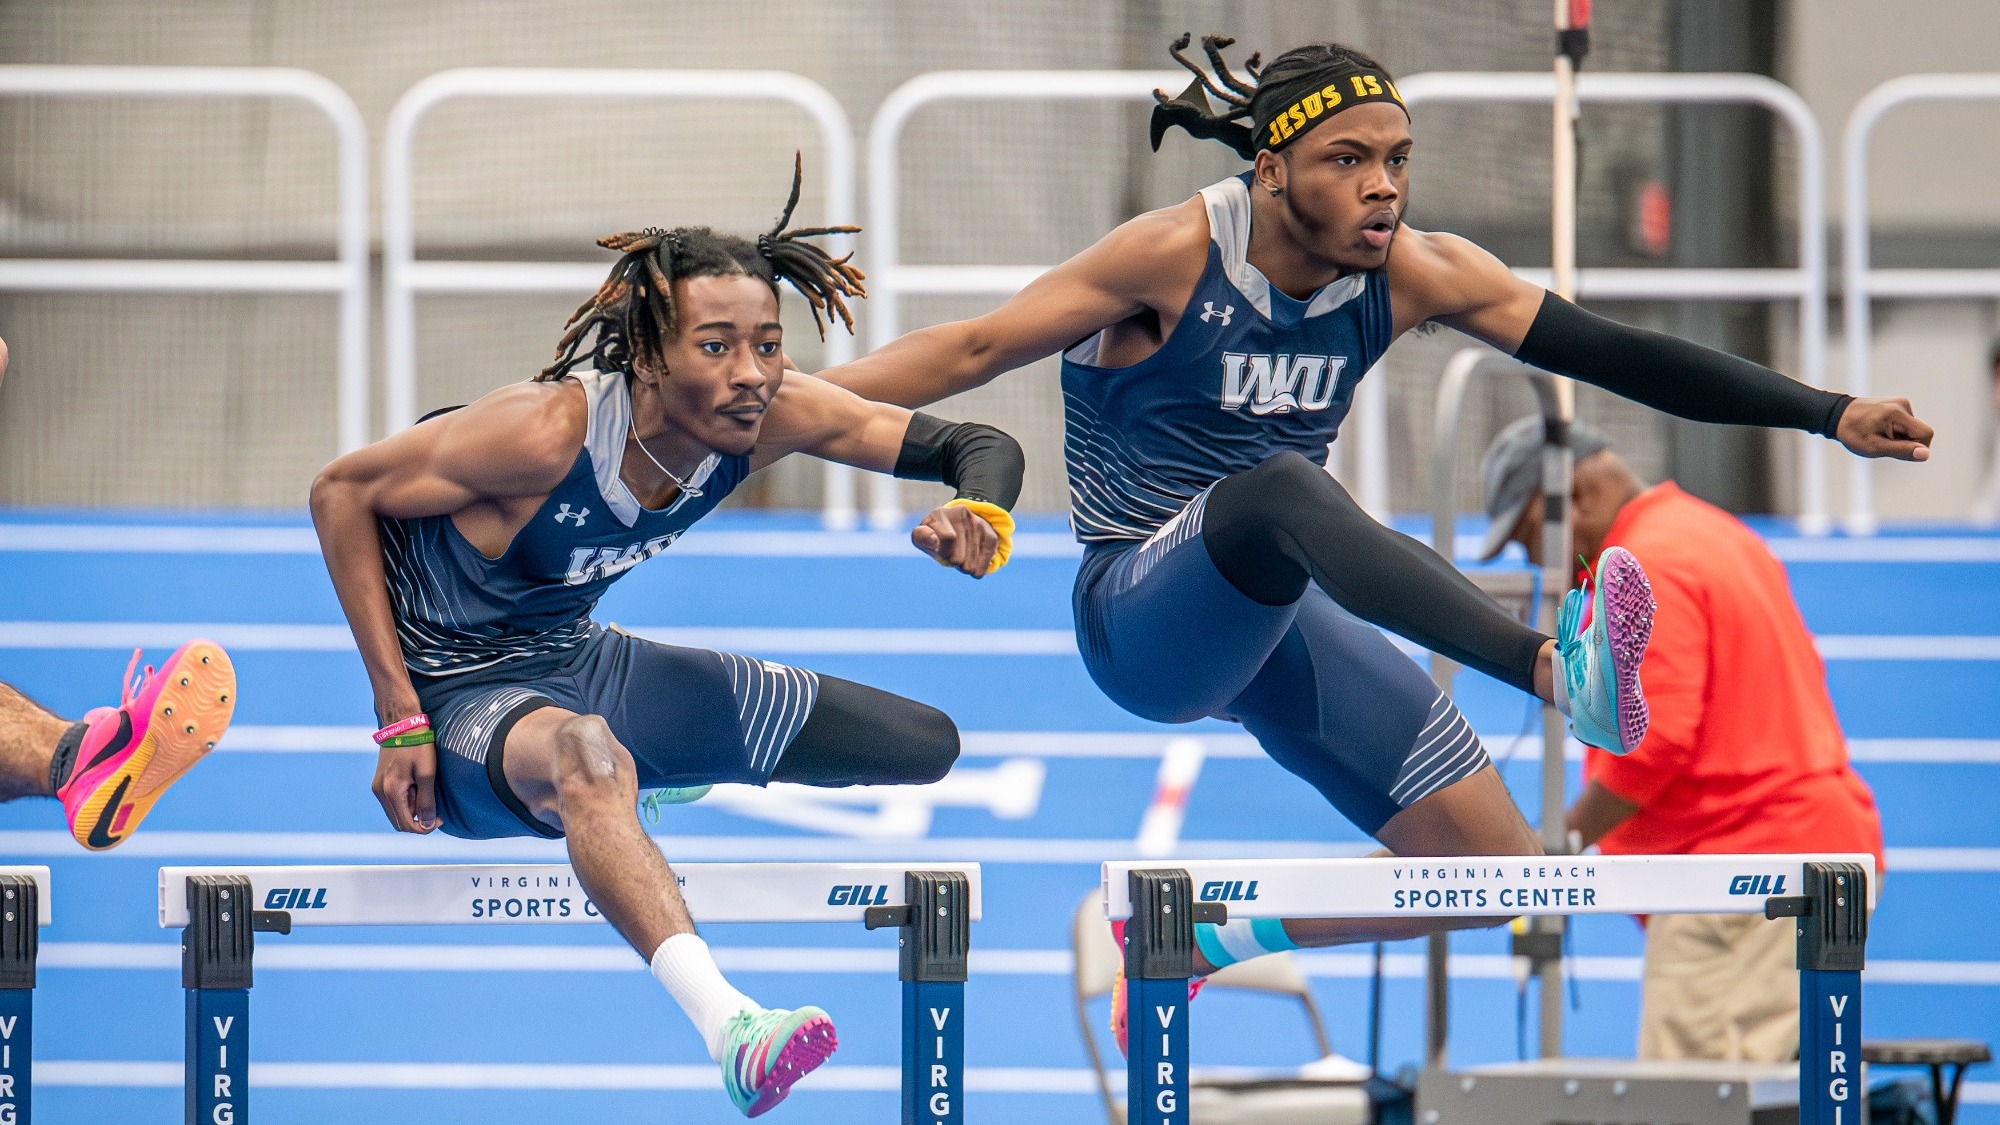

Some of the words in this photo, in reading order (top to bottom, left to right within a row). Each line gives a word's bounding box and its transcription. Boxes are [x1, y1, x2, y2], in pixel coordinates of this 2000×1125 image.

[1268, 84, 1342, 146] JESUS
[1350, 75, 1383, 97] IS
[1220, 351, 1348, 415] VWU
[471, 877, 578, 888] VIRGINI
[1394, 868, 1504, 879] VIRGINIA
[1523, 867, 1596, 878] BEACH
[827, 885, 889, 905] GILL
[1200, 880, 1259, 901] GILL
[1728, 875, 1787, 895] GILL
[264, 888, 328, 909] GILL
[472, 898, 571, 918] SPORTS
[1394, 889, 1487, 908] SPORTS
[1500, 888, 1596, 907] CENTER
[930, 1008, 950, 1125] VIRG
[1156, 1006, 1176, 1125] VIRG
